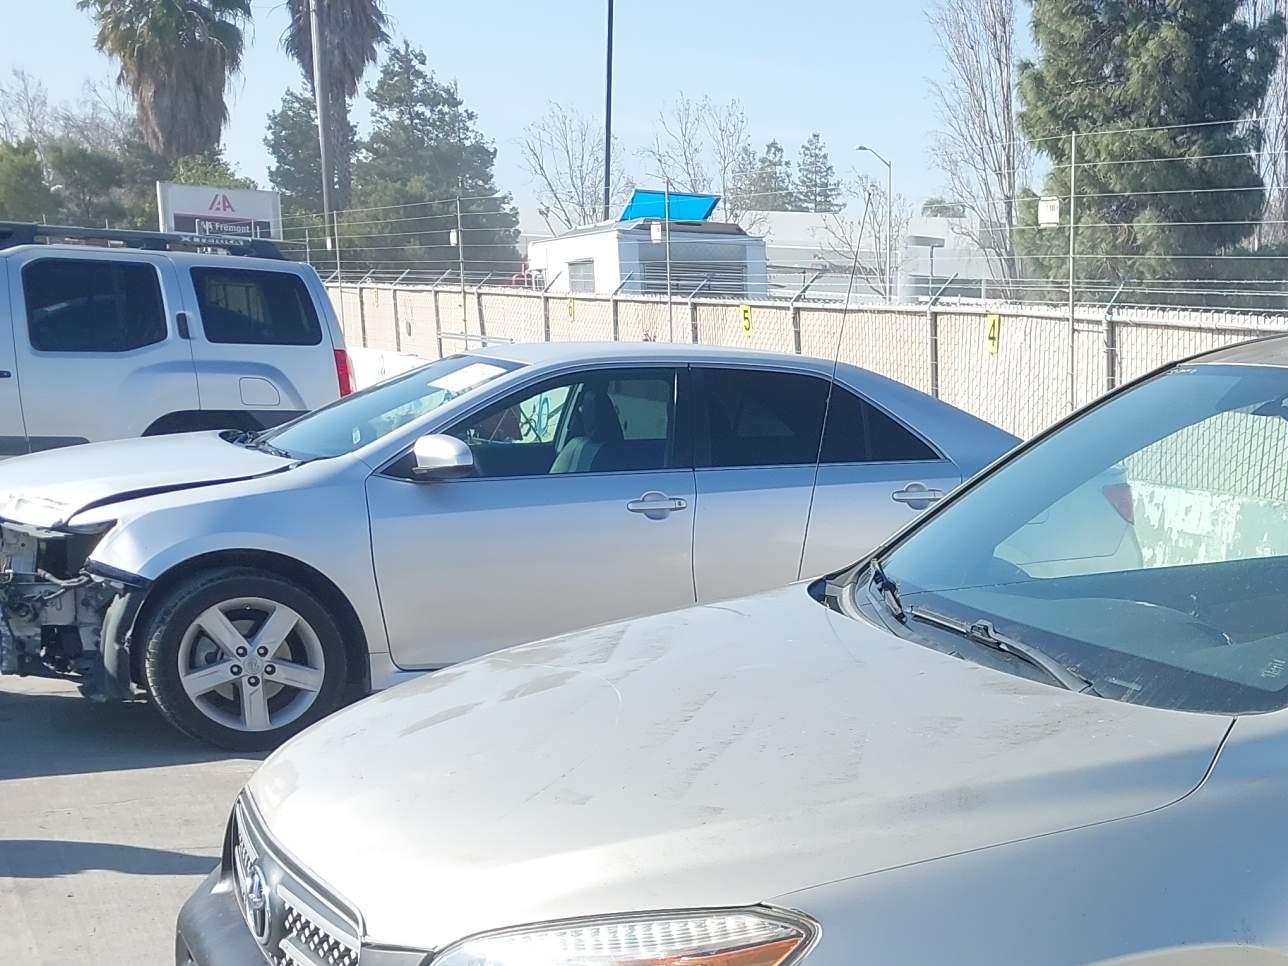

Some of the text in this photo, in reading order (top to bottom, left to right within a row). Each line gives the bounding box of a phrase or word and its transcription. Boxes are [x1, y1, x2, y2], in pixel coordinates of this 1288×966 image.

[215, 221, 250, 233] Fremont
[743, 309, 751, 332] 5
[988, 319, 996, 347] 4
